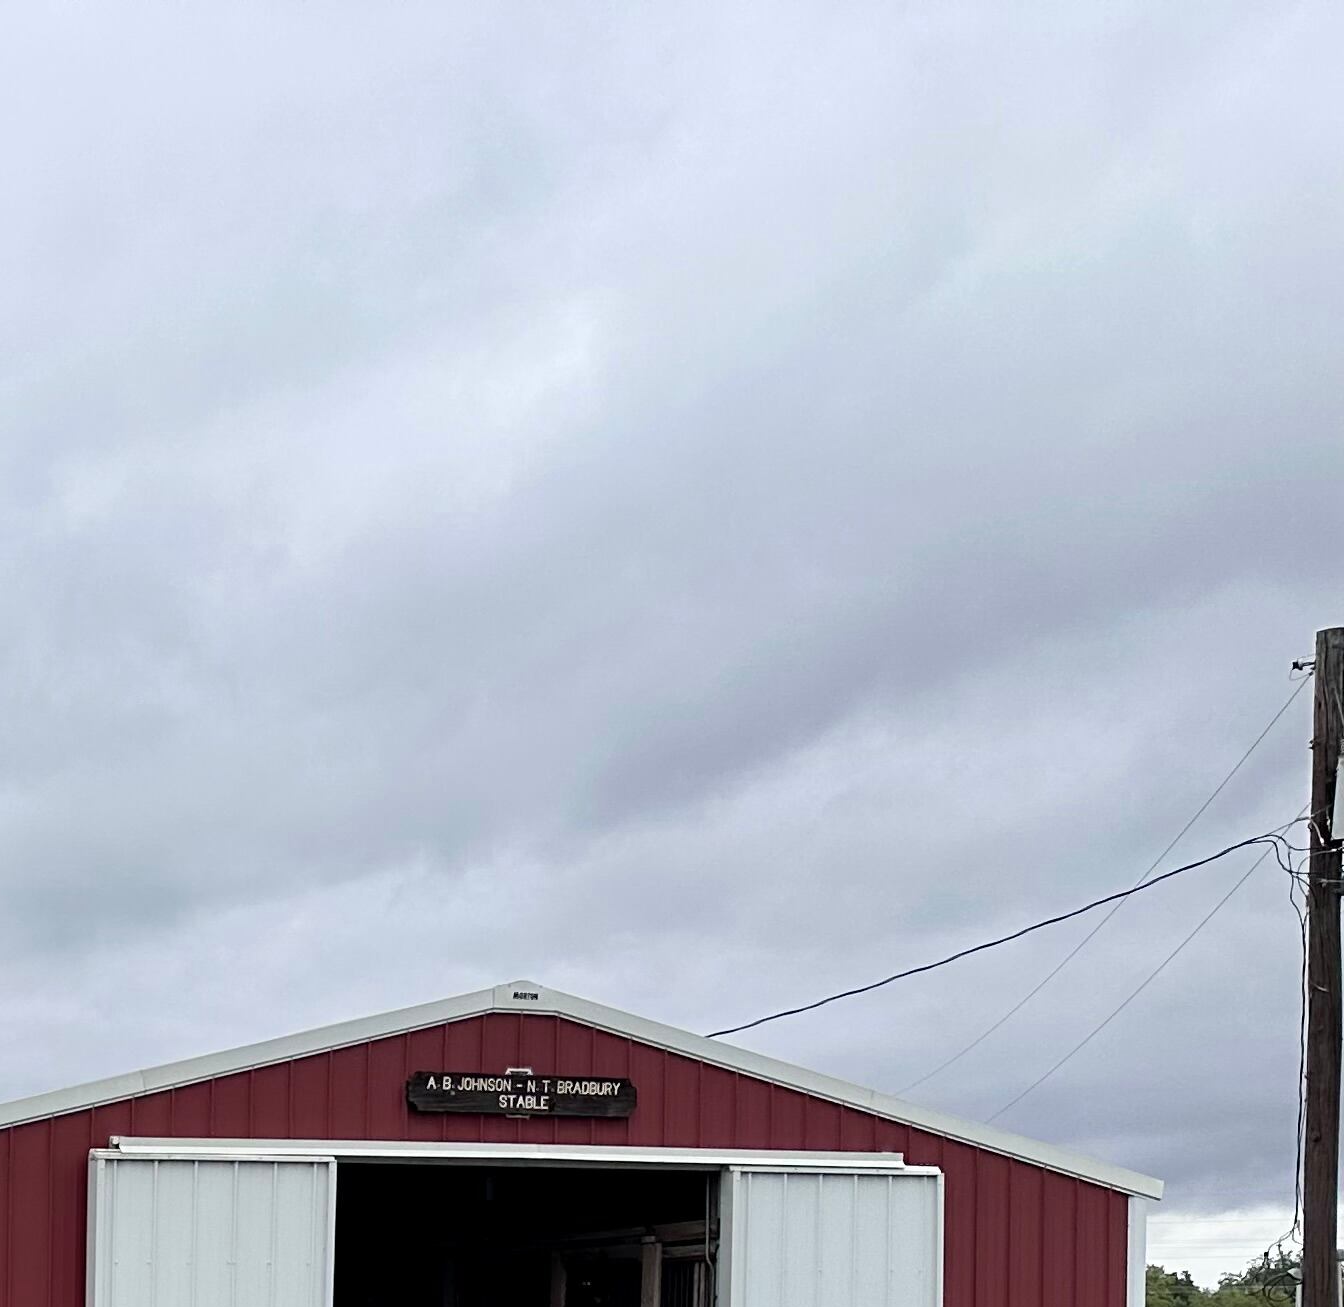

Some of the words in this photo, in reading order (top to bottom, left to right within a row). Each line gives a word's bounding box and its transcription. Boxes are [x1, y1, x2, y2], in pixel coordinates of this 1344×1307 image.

[457, 1077, 512, 1092] JOHNSON
[557, 1081, 620, 1096] BRADBURY
[499, 1096, 549, 1110] STABLE
